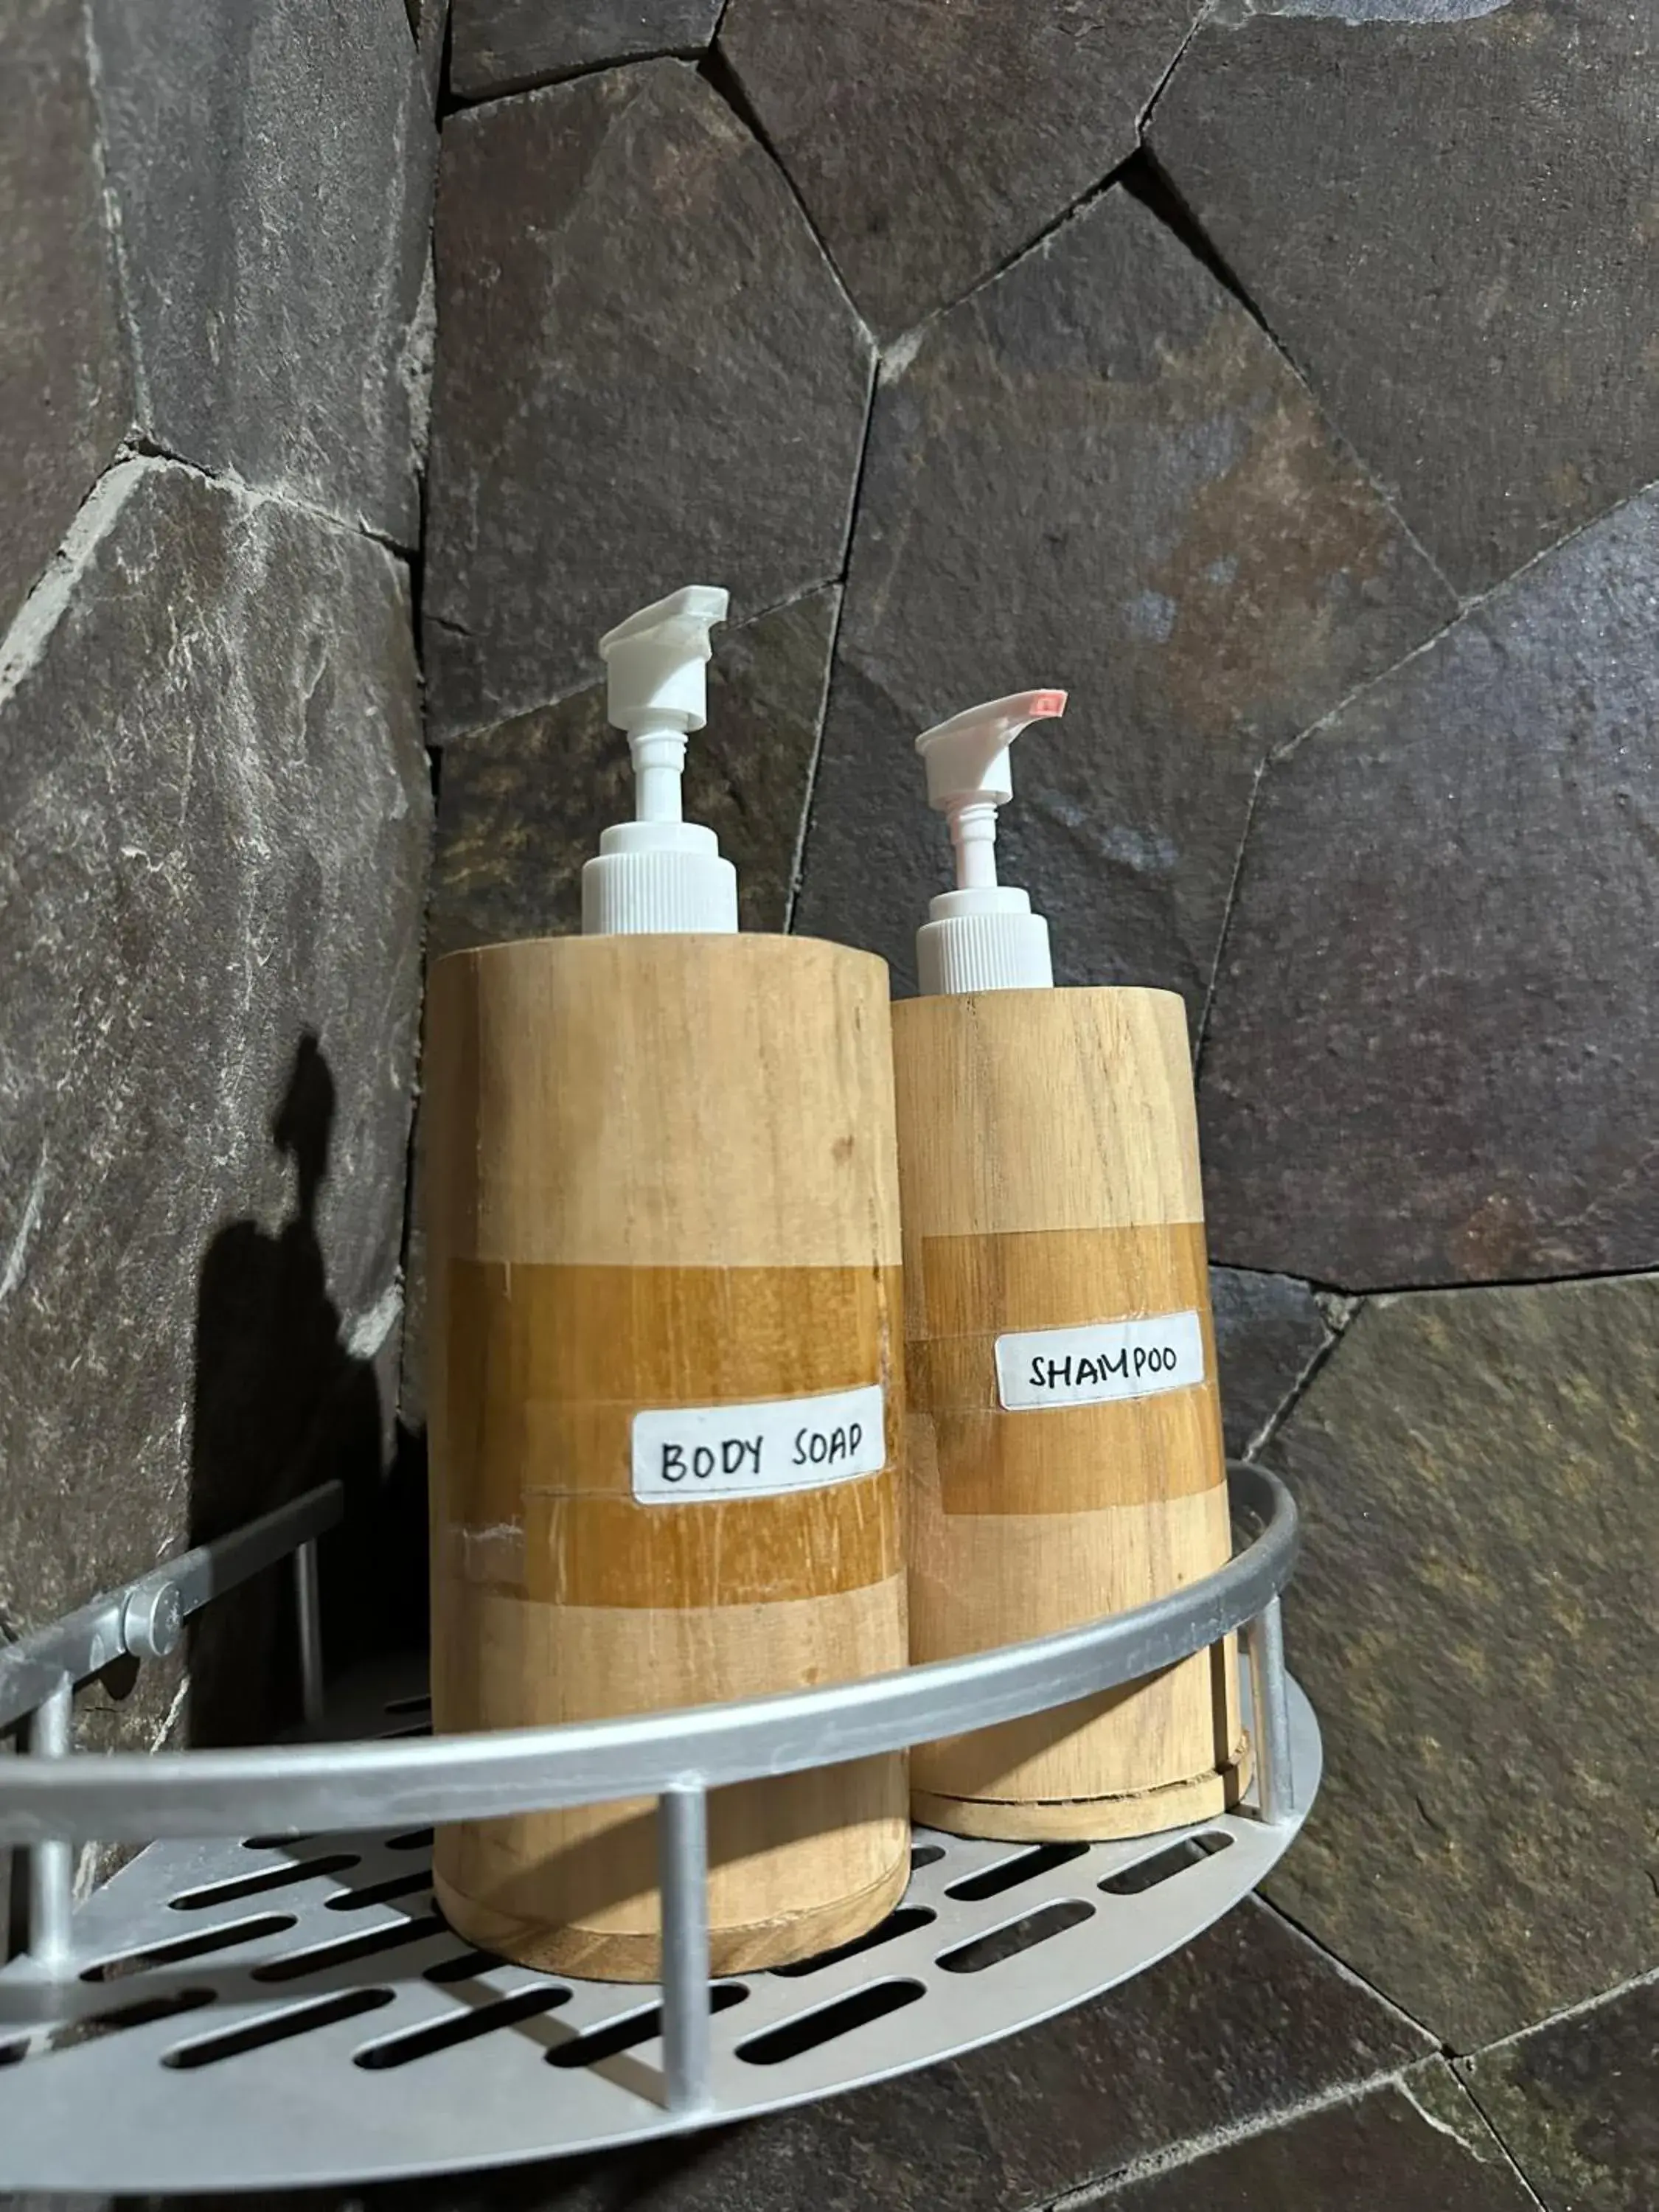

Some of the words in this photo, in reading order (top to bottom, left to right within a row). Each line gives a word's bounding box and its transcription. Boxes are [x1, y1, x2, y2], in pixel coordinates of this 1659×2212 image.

[1029, 1347, 1176, 1388] SHAMPOO
[661, 1435, 763, 1482] BODY
[792, 1423, 862, 1465] SOAP
